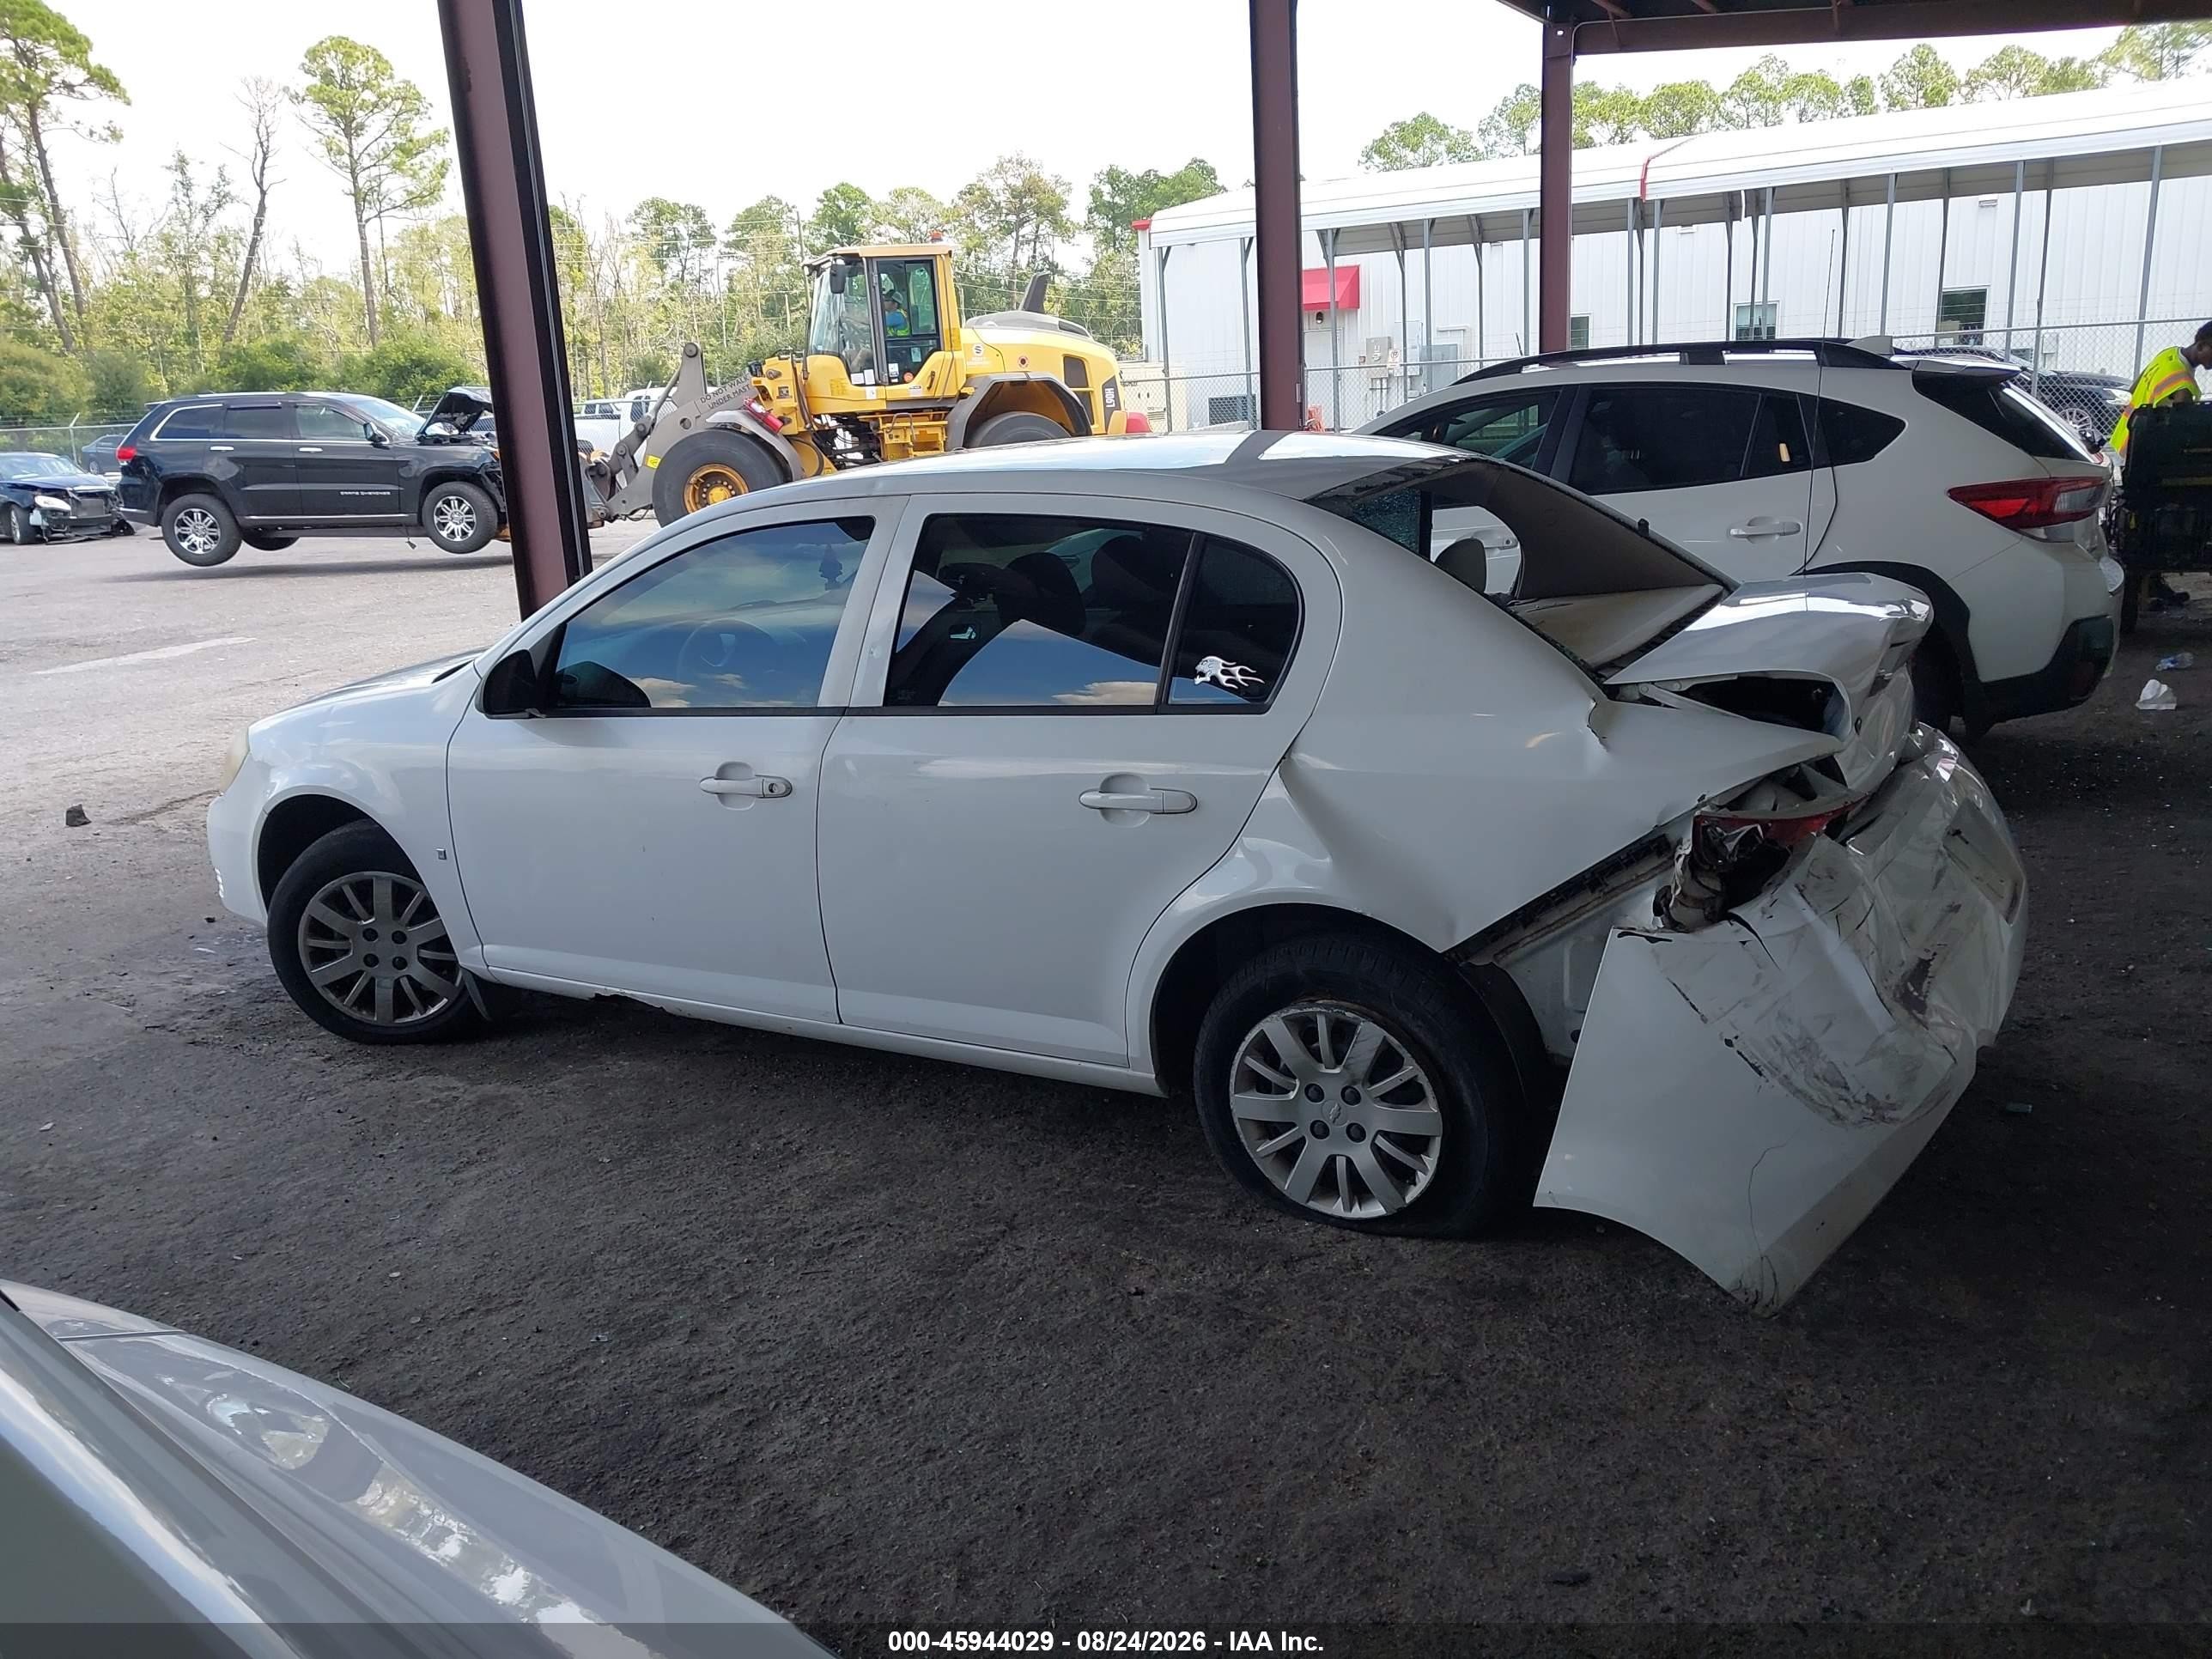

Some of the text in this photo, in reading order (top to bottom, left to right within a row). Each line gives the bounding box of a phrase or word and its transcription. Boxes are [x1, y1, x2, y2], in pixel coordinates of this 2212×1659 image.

[700, 376, 750, 403] DO NOT WALK
[708, 384, 750, 410] UNDER MAST
[1104, 387, 1115, 408] L90H
